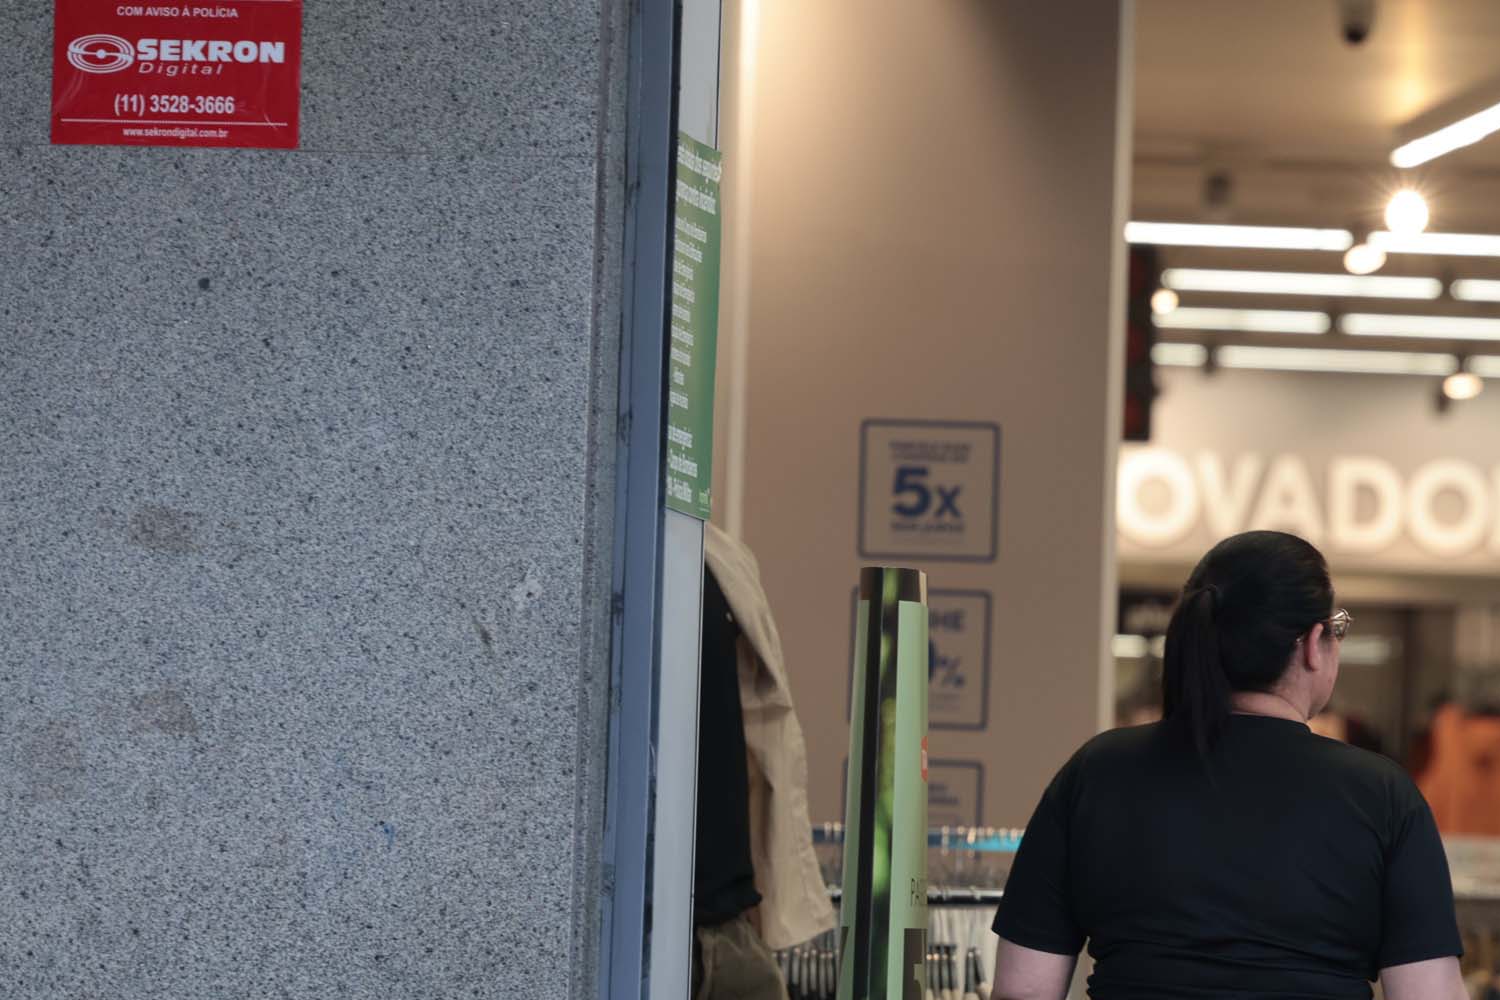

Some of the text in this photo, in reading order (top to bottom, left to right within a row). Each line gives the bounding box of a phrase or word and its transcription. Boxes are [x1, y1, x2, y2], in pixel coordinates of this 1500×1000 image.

[117, 7, 142, 16] COM
[146, 7, 179, 17] AVISO
[193, 6, 238, 17] POLÍCIA
[136, 38, 285, 63] SEKRON
[139, 62, 222, 76] Digital
[114, 94, 235, 116] (11) 3528-3666
[123, 127, 228, 139] www.sekrondigital.com.br
[892, 466, 963, 519] 5x
